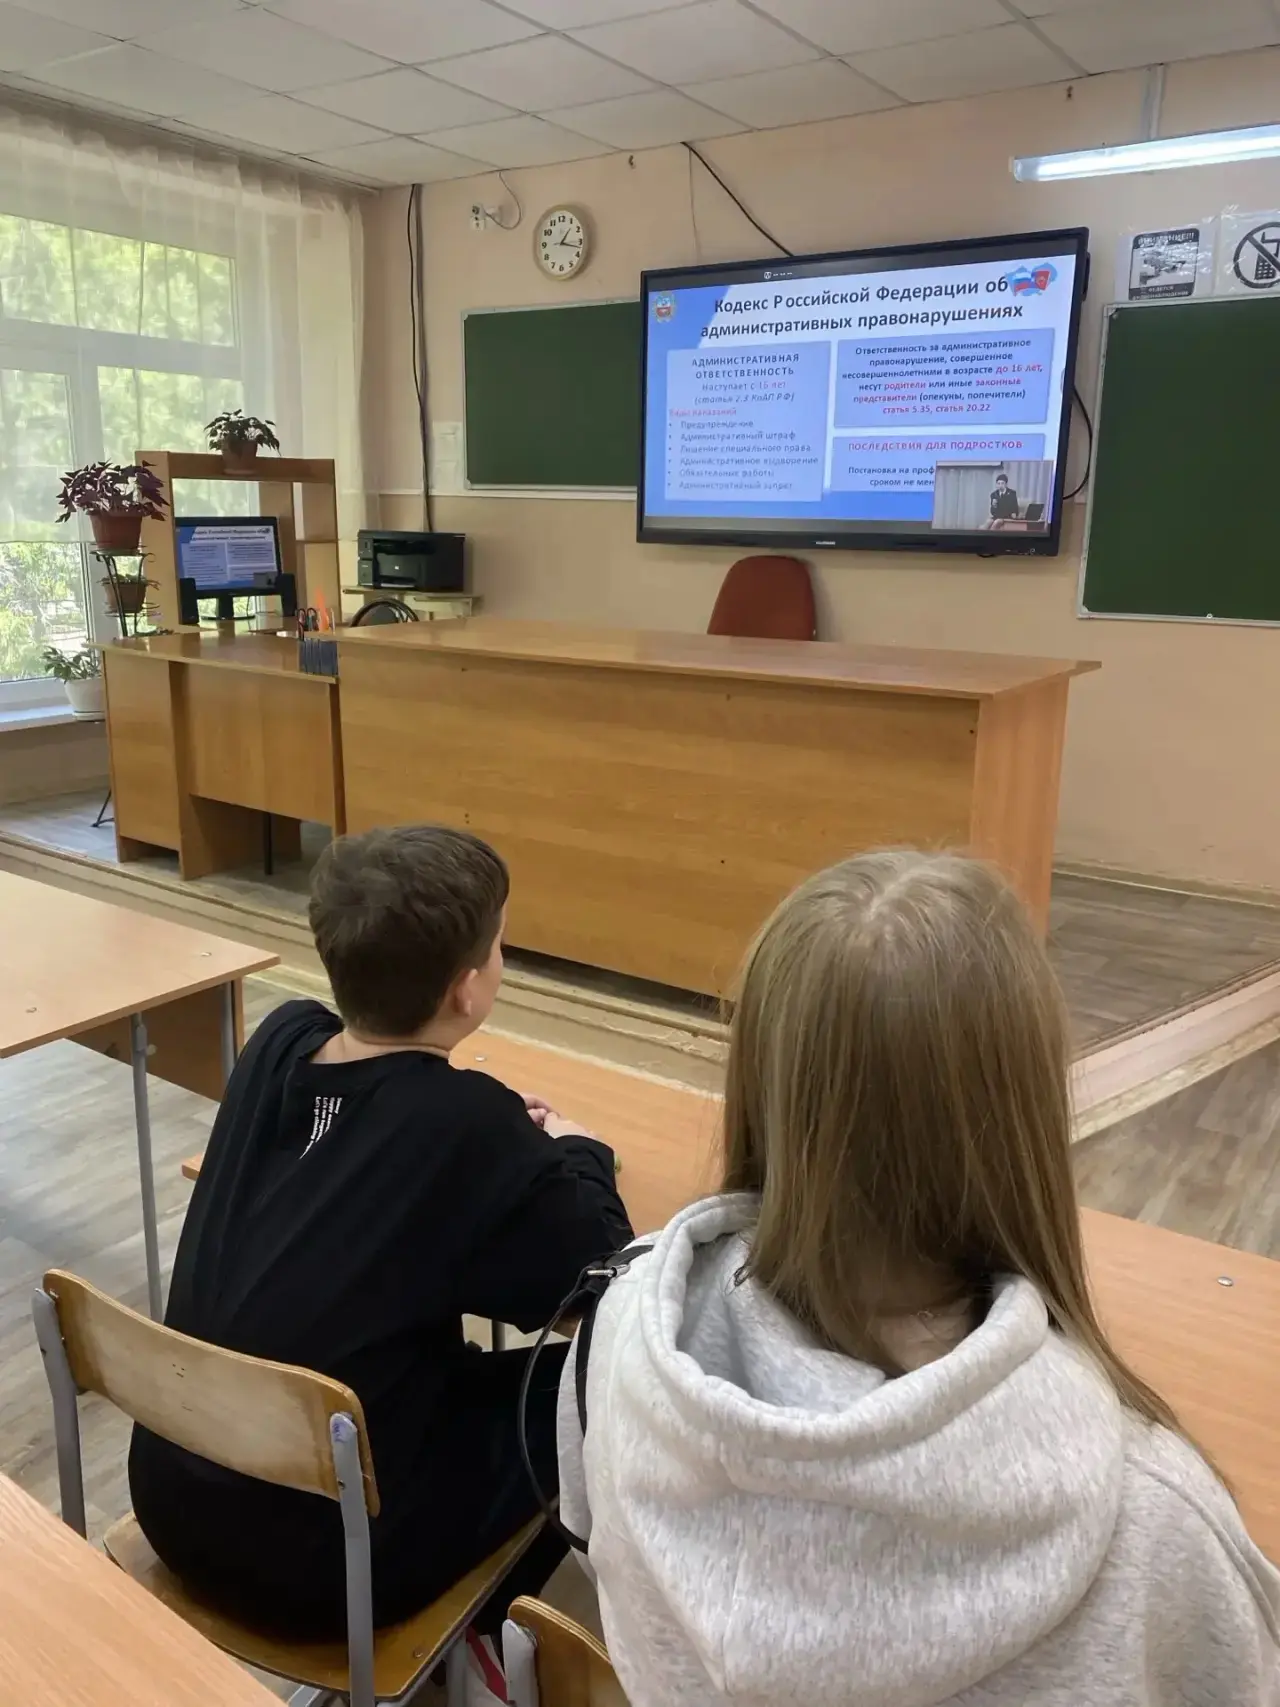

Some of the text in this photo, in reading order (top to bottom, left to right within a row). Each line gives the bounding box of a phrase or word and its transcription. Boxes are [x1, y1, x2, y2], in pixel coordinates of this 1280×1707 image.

[715, 276, 1008, 314] Кодекс Российской Федерации об
[701, 305, 1022, 339] административных правонарушениях
[855, 345, 927, 355] Ответственность
[942, 340, 1031, 352] административное
[692, 354, 800, 368] АДМИНИСТРАТИВНАЯ
[870, 353, 1013, 367] правонарушение, совершенное
[696, 367, 794, 379] ОТВЕТСТВЕННОСТЬ
[842, 368, 942, 380] несовершеннолетними
[953, 366, 992, 376] возрасте
[996, 366, 1008, 374] до
[1025, 364, 1043, 373] лет,
[702, 382, 747, 392] Наступает
[884, 382, 926, 391] родители
[976, 378, 1021, 386] законные
[854, 394, 917, 403] представители
[968, 389, 1026, 400] попечители)
[912, 404, 933, 416] 5.35,
[966, 404, 991, 412] 20.22
[766, 430, 796, 441] штраф
[849, 440, 1023, 452] ПОСЛЕДСТВИЯ ДЛЯ ПОДРОСТКОВ
